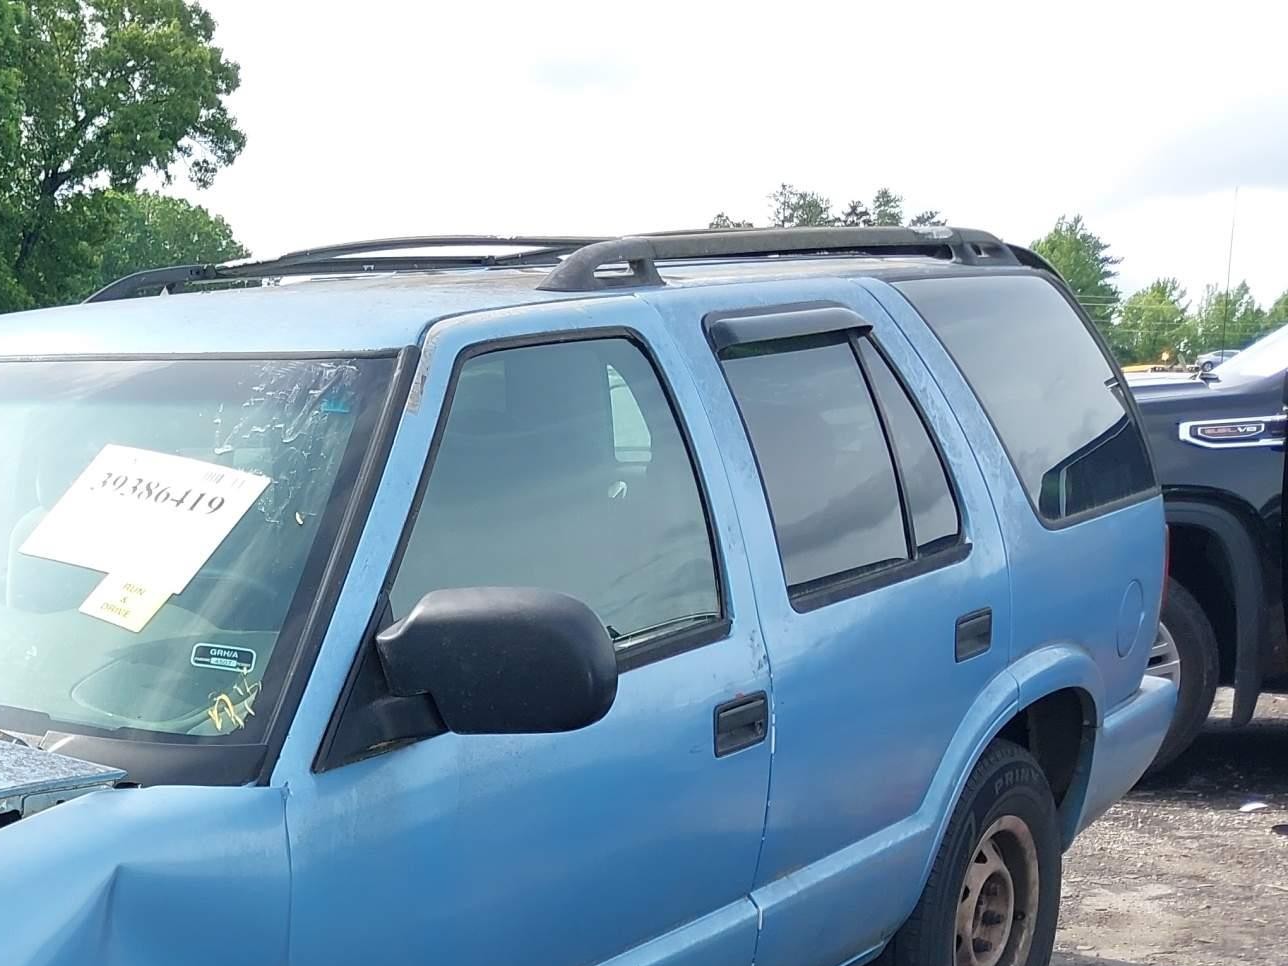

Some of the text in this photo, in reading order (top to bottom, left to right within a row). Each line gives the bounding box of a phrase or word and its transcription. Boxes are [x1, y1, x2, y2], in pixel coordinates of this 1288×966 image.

[89, 471, 226, 515] 39386419
[100, 602, 131, 618] DRIVE
[209, 648, 239, 659] GRH/A
